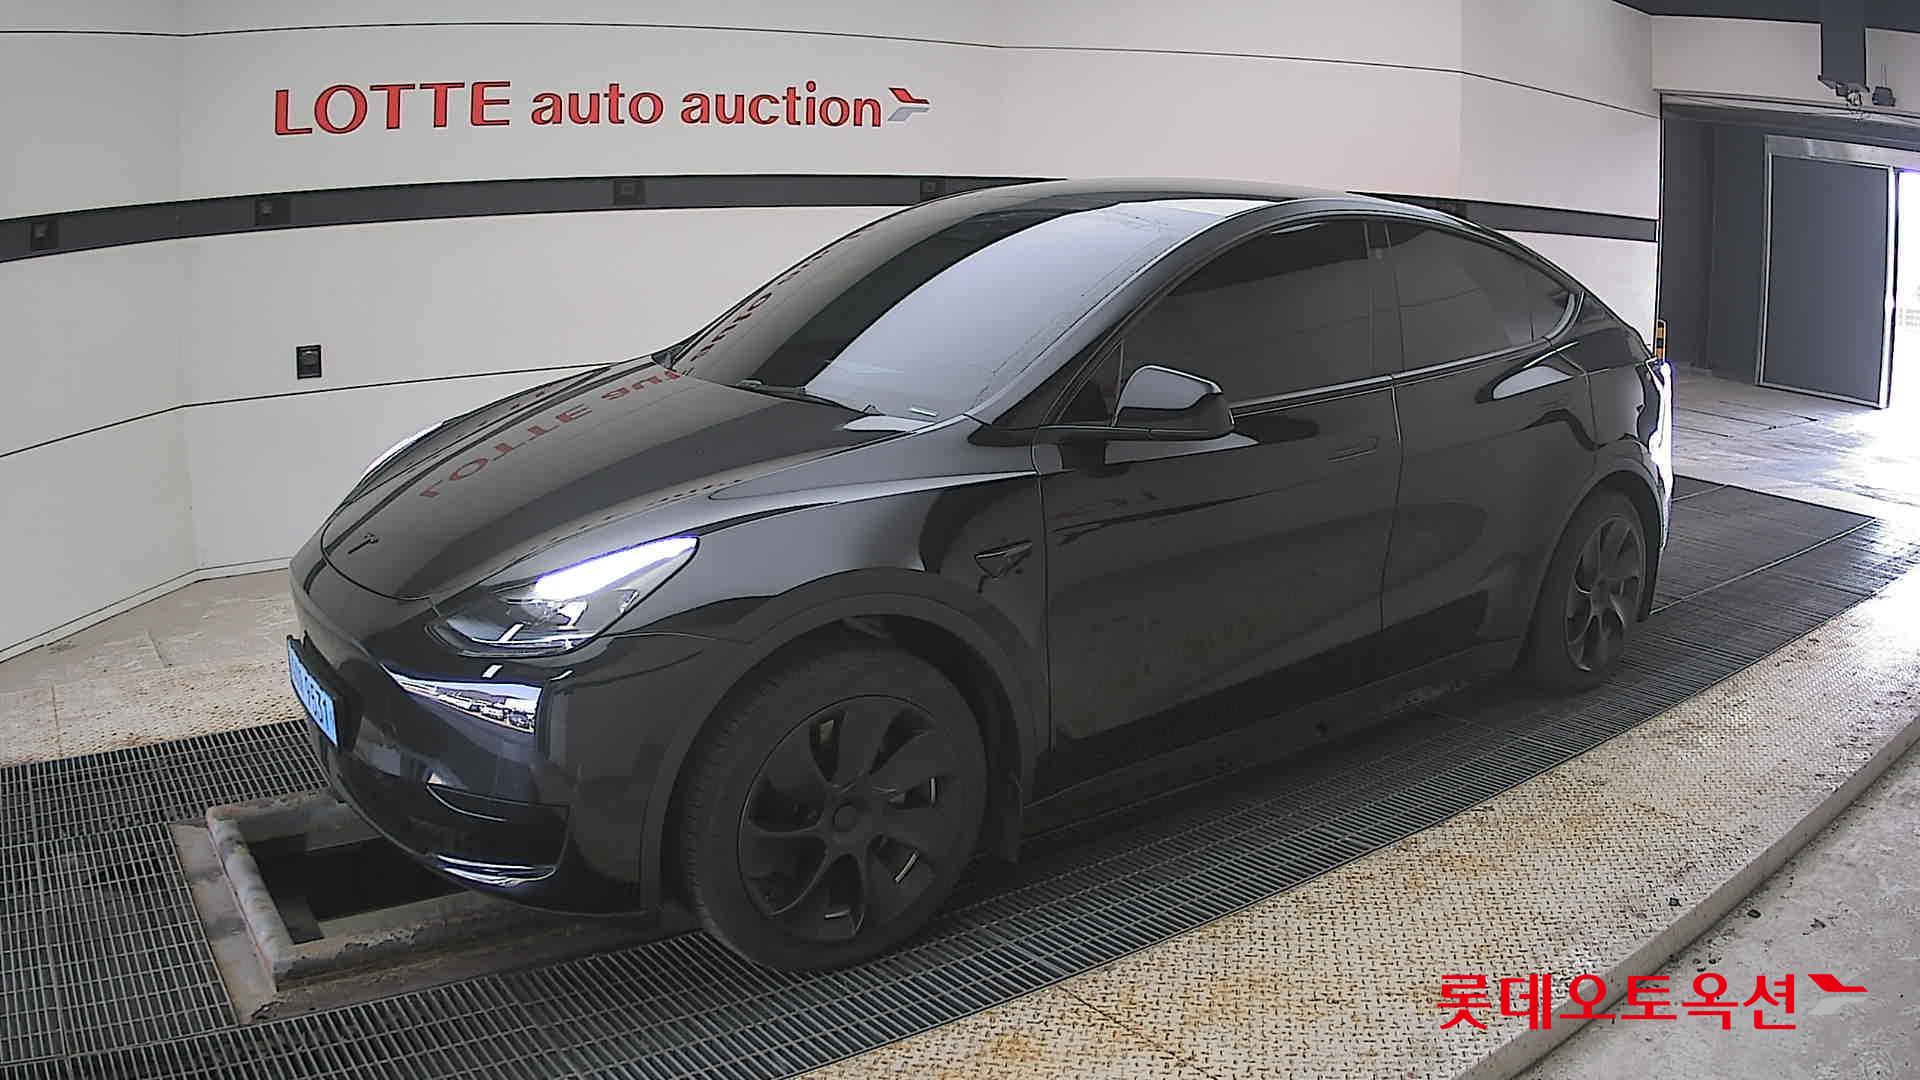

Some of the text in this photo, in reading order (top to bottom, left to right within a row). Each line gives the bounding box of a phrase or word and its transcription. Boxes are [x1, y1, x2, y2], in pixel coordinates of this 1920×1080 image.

[274, 80, 882, 136] LOTTE auto auction
